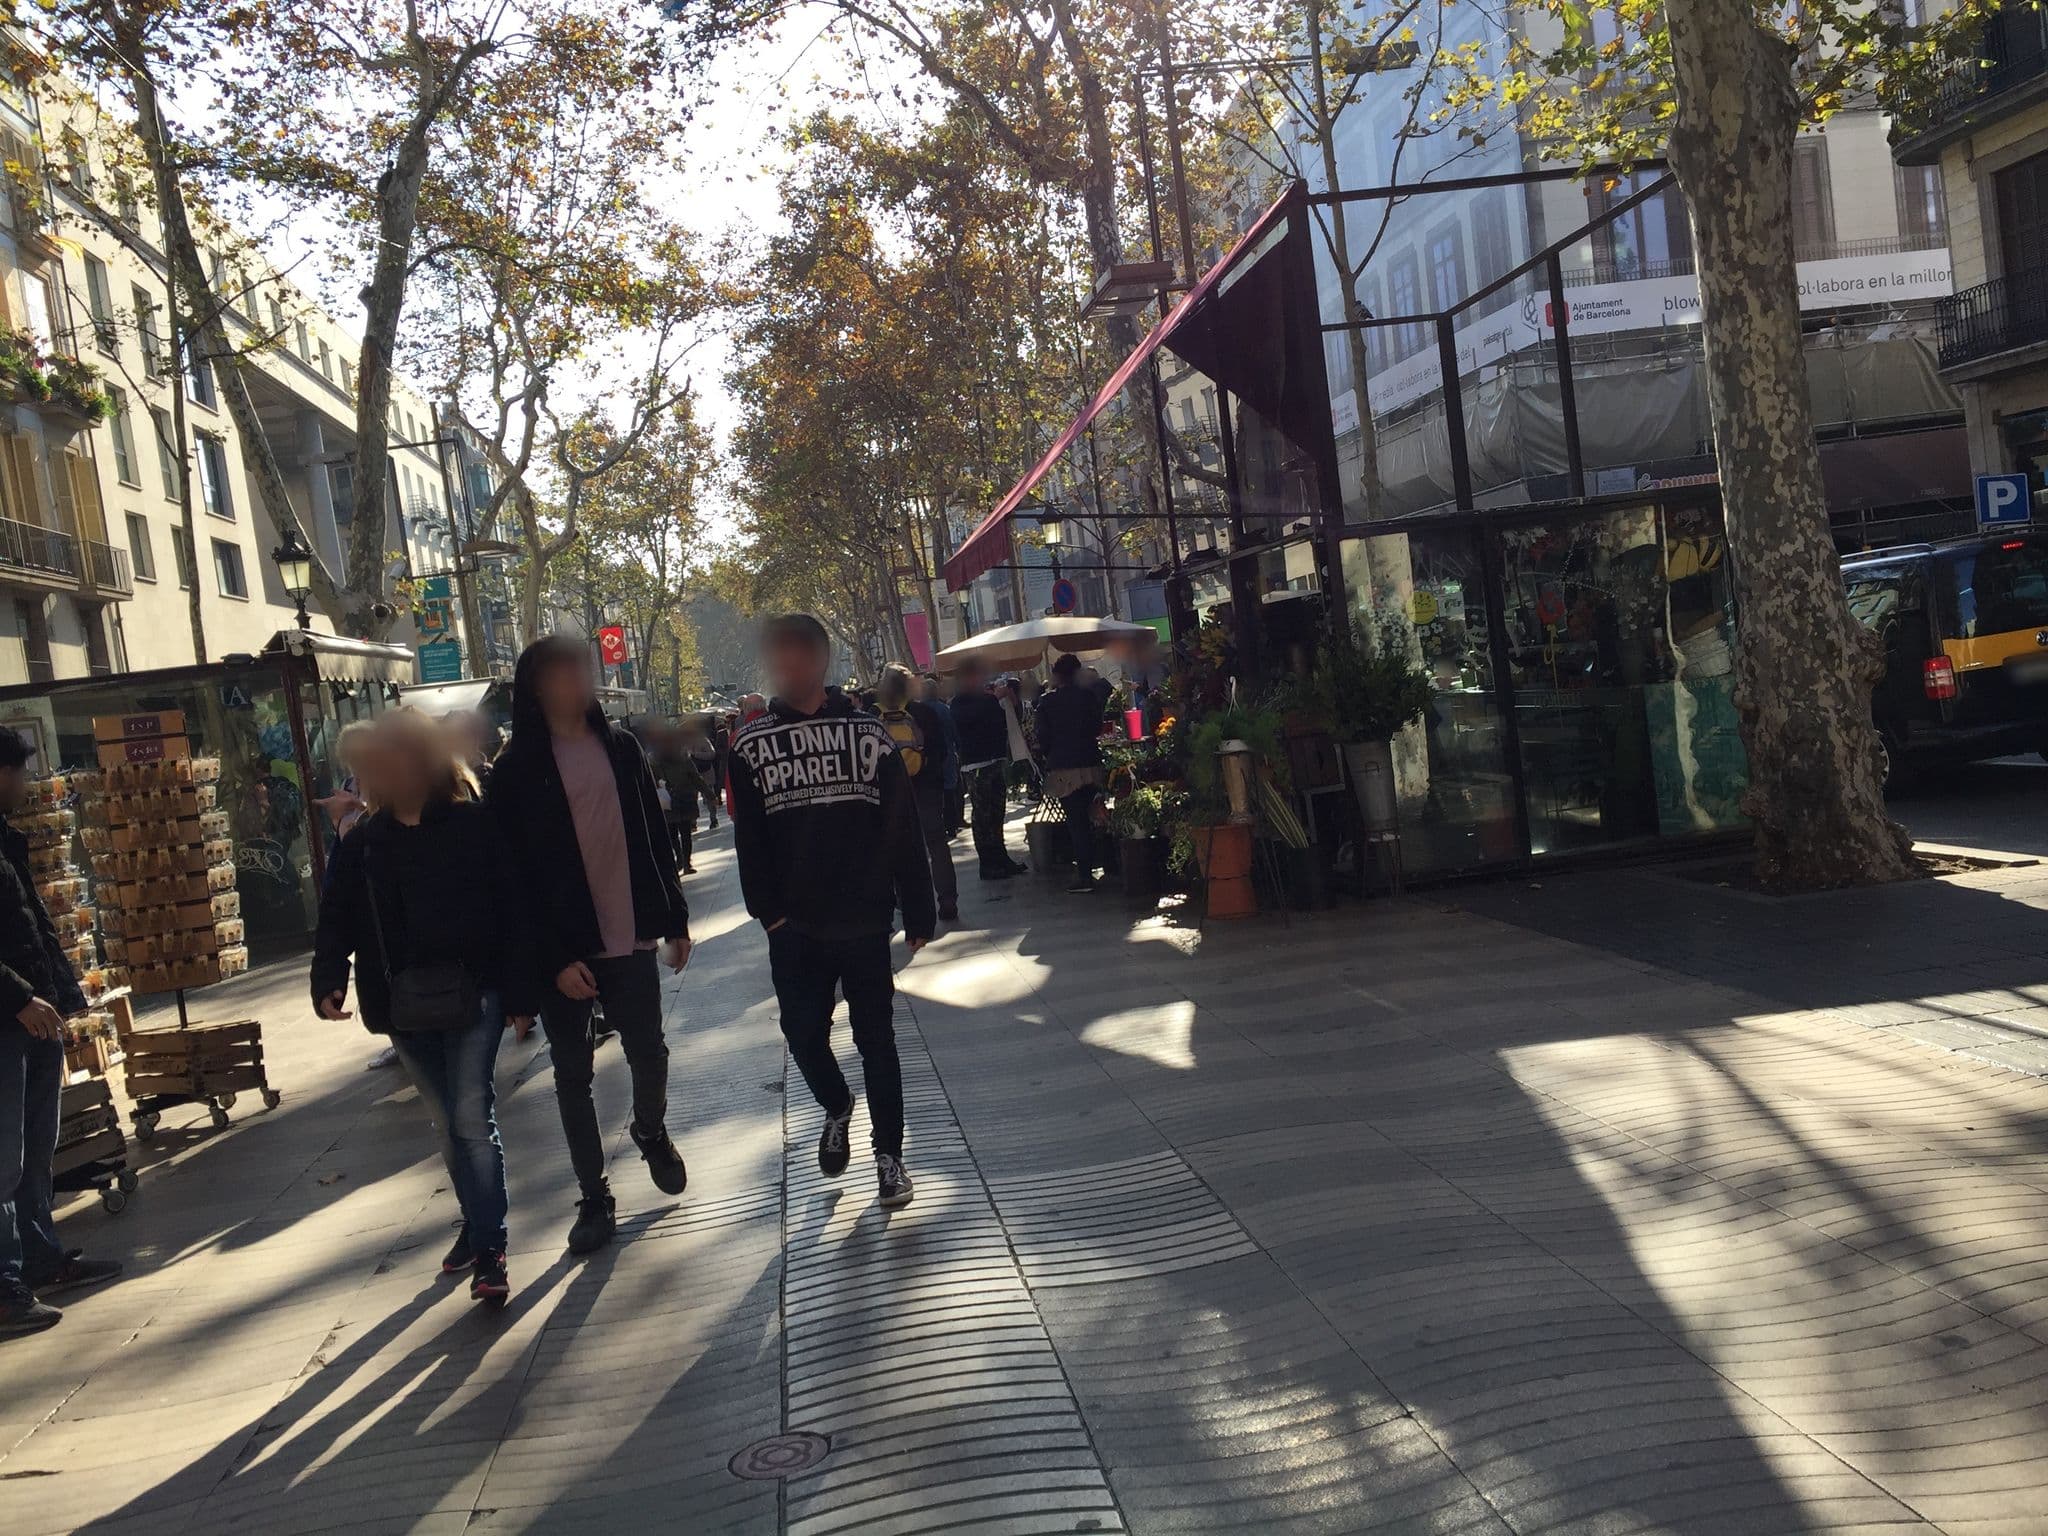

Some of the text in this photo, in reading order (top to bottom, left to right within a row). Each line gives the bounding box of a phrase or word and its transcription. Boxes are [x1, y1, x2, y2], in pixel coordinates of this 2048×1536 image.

[1797, 268, 1952, 296] ol·labora en la millor
[1572, 298, 1624, 313] Ajuntament
[1664, 296, 1700, 311] blow
[1573, 308, 1632, 322] de Barcelona
[1987, 481, 2018, 518] P
[790, 725, 848, 756] DNM
